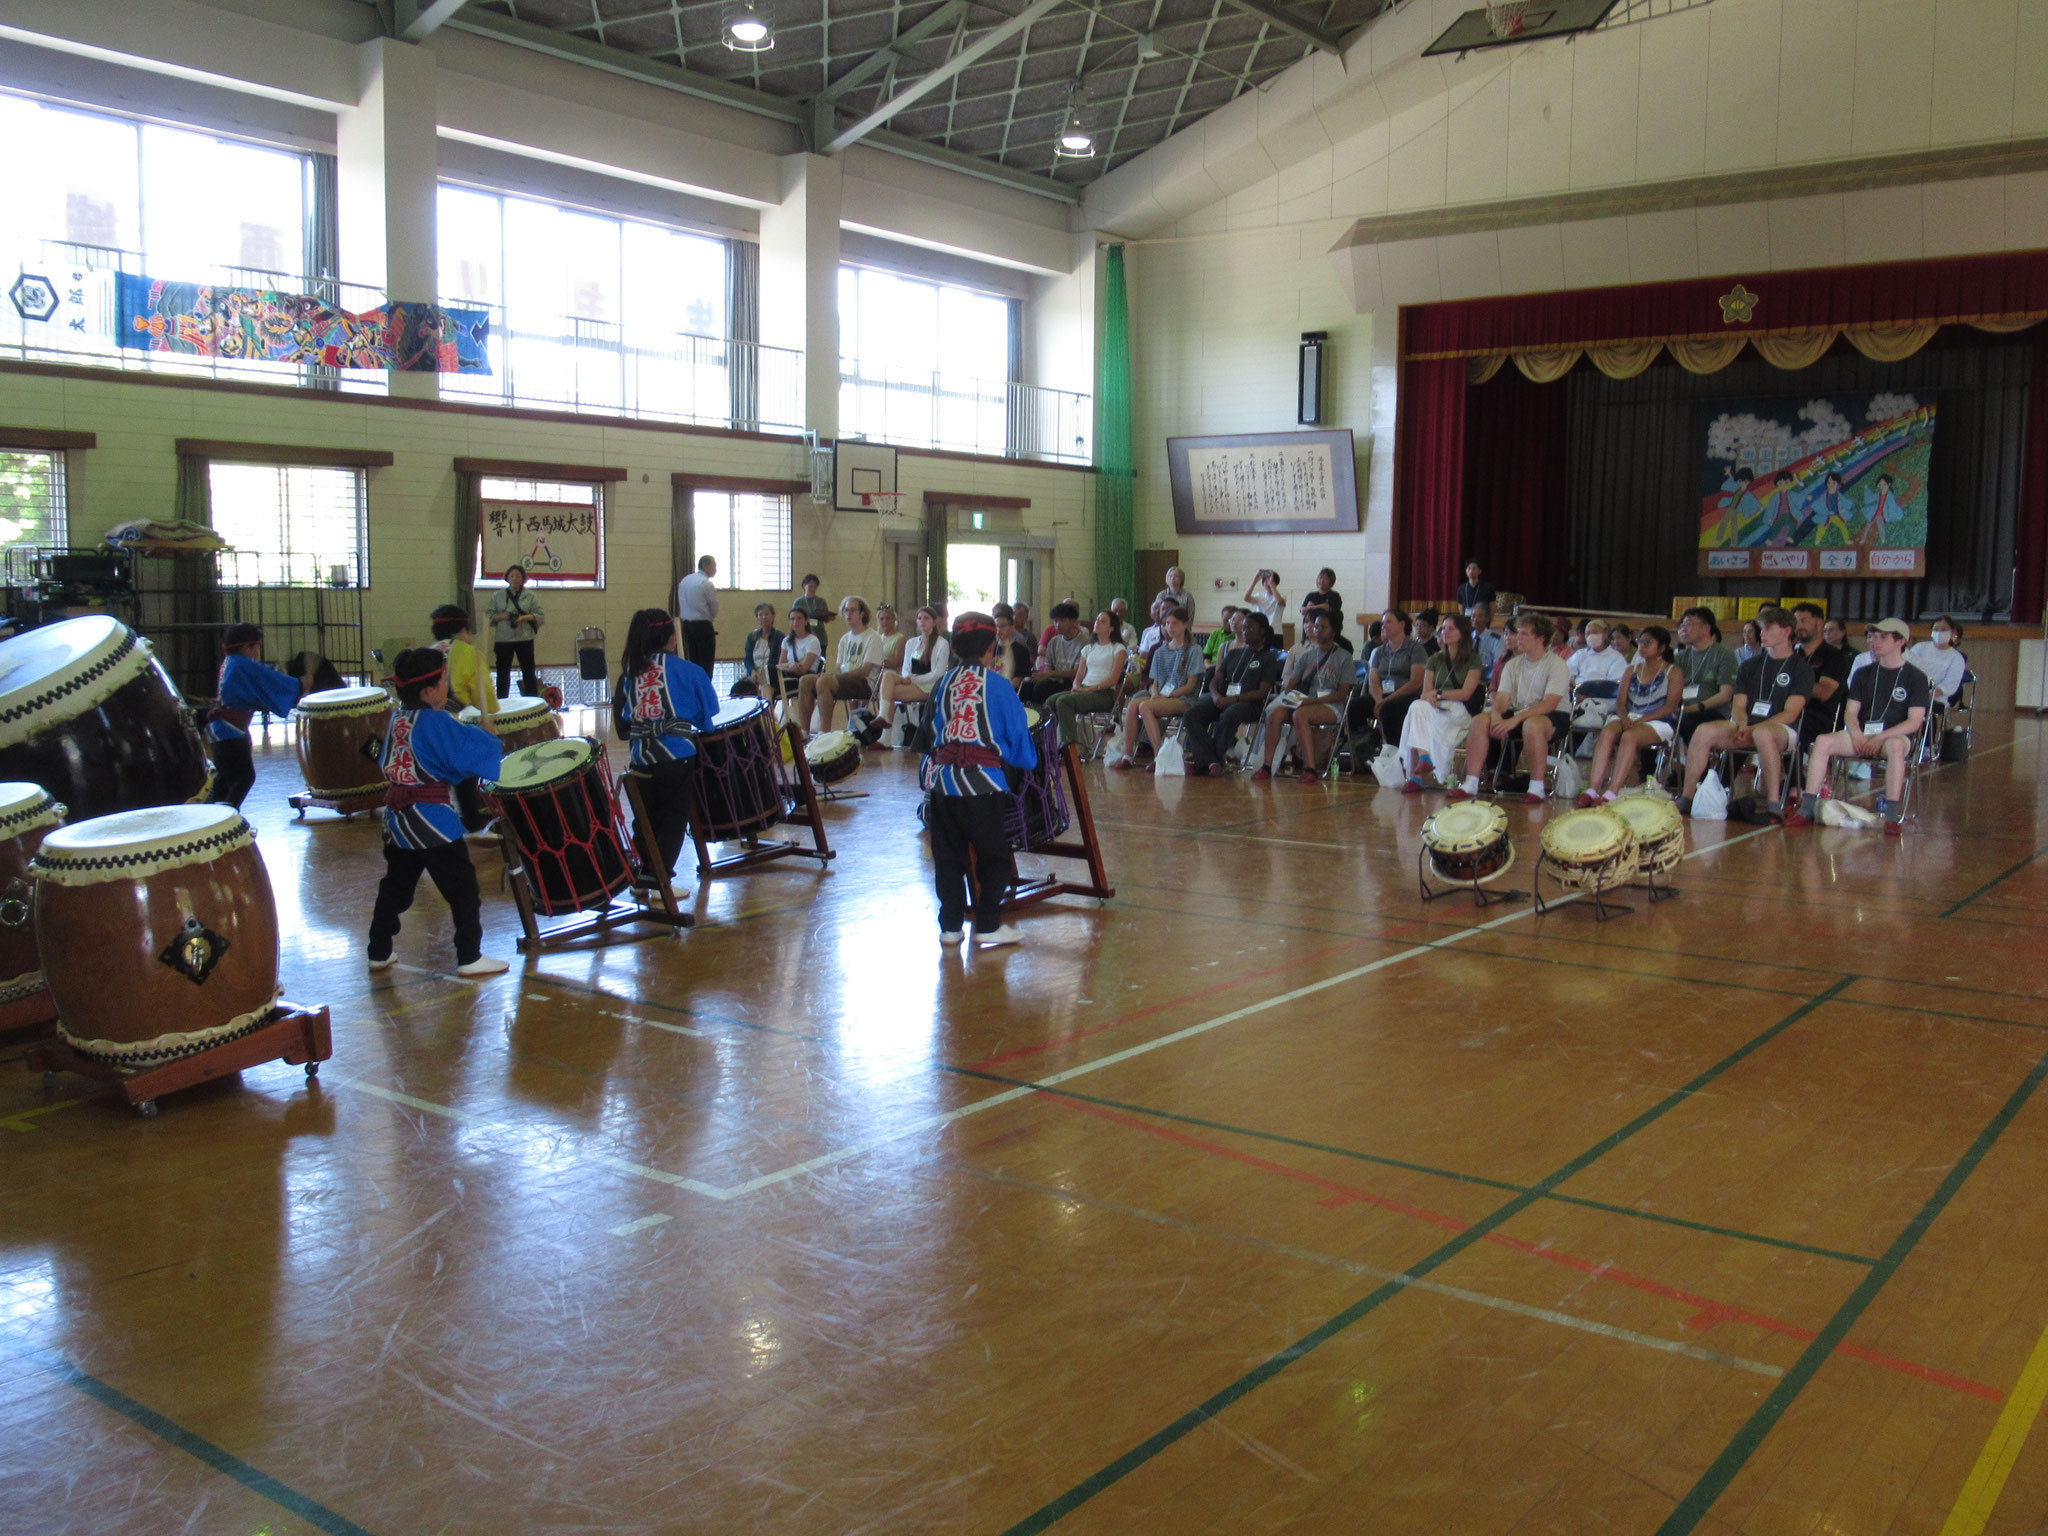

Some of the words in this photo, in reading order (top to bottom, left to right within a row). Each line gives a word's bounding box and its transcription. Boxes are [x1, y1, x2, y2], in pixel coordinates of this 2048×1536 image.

[489, 509, 596, 538] 響け西馬城太鼓
[1709, 555, 1749, 567] あいさつ
[1762, 553, 1805, 568] 思いやり
[1827, 554, 1853, 567] 全力
[1871, 552, 1914, 566] 自分から
[945, 670, 984, 741] 童龍
